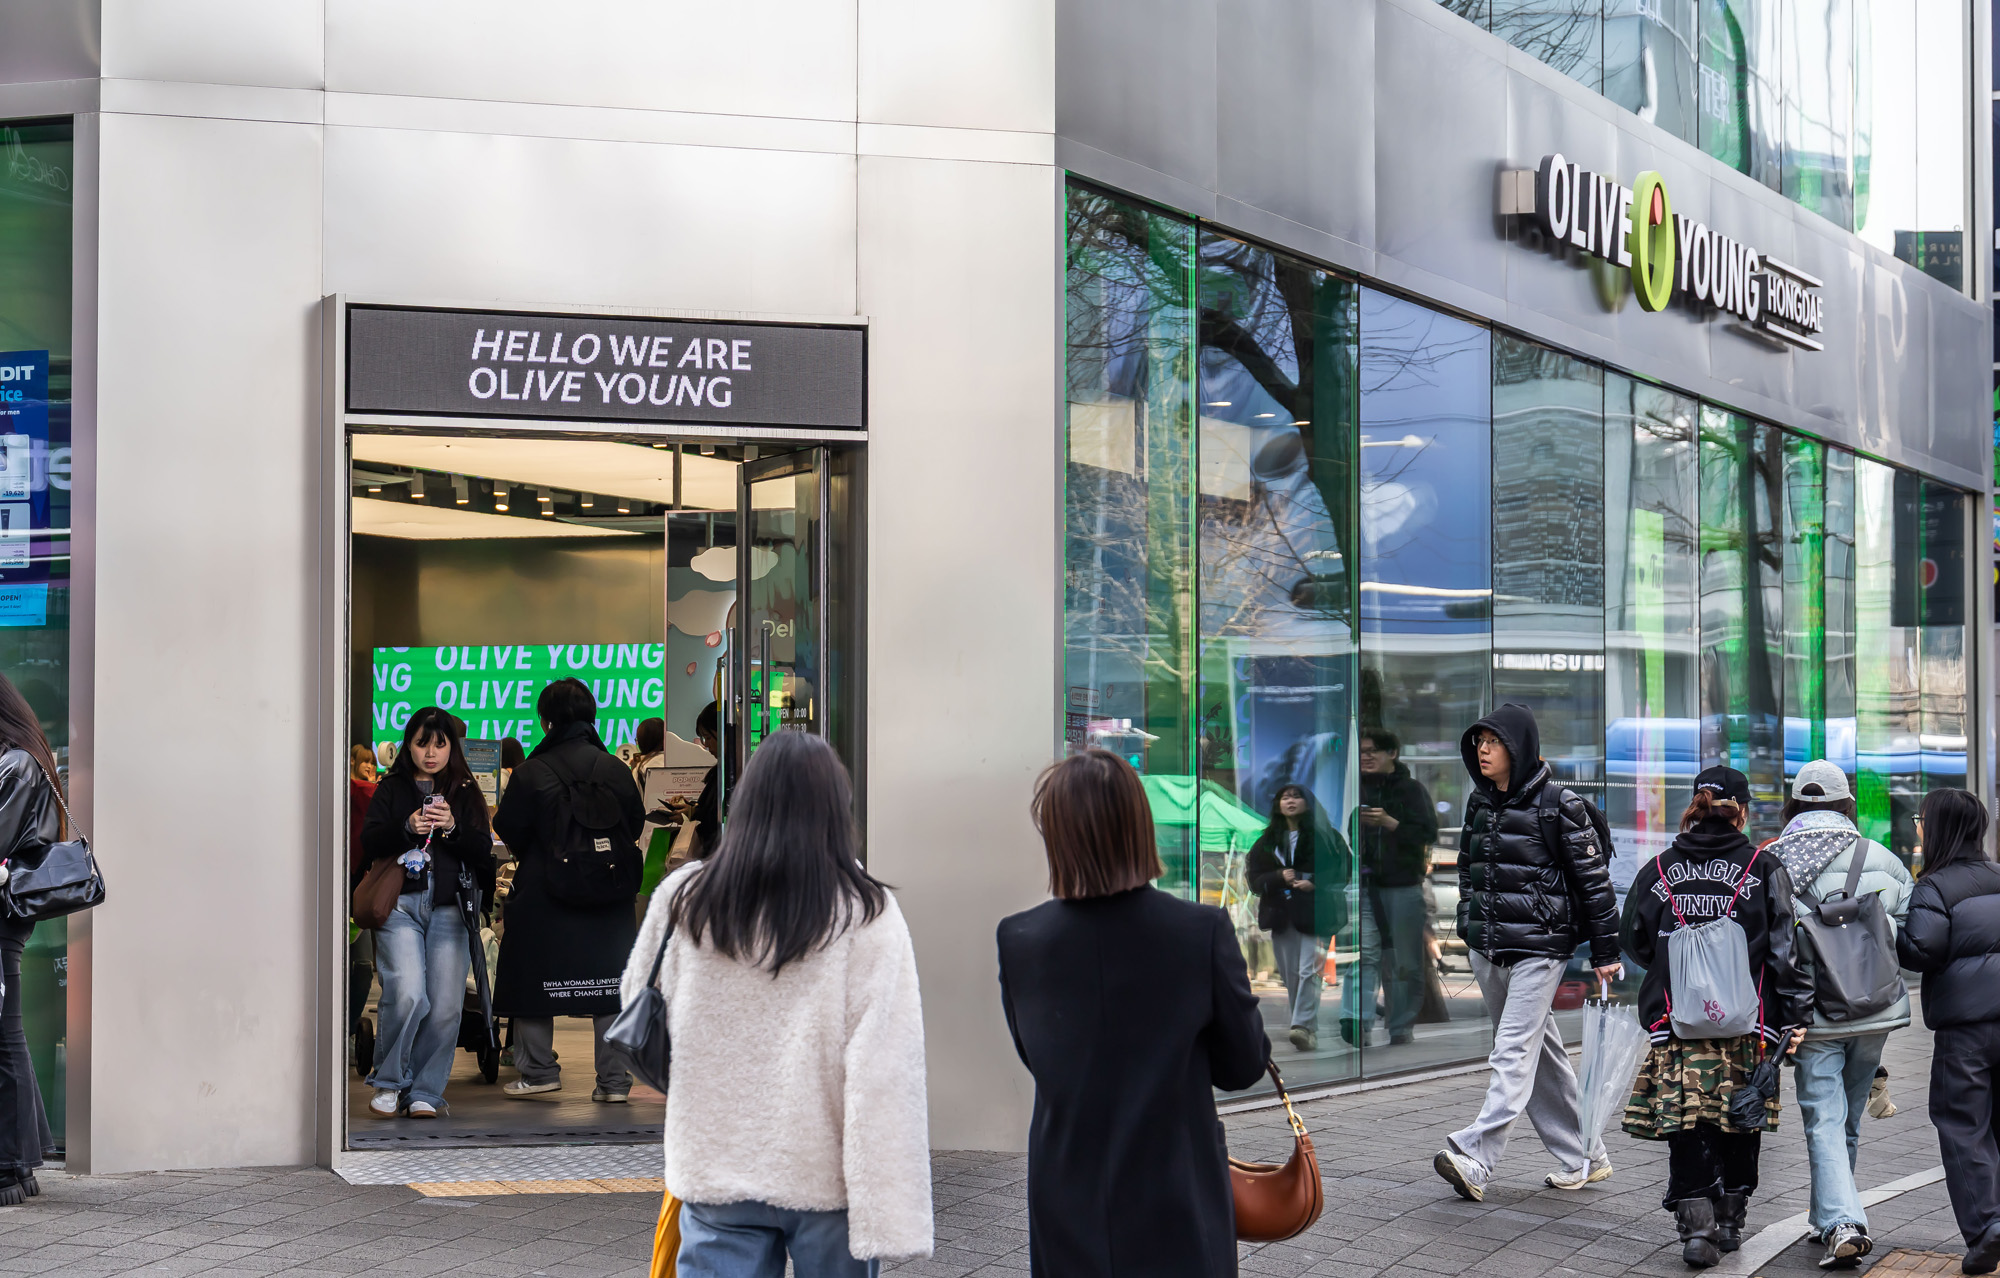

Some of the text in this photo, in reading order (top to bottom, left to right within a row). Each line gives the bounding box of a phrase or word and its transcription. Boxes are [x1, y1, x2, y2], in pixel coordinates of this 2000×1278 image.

[1548, 153, 1824, 333] OLIVE YOUNG HONGDAE
[471, 328, 752, 371] HELLO WE ARE
[468, 366, 732, 408] OLIVE YOUNG
[435, 643, 664, 671] OLIVE YOUNG
[435, 678, 663, 710] OLIVE UNG
[389, 747, 394, 760] 3
[622, 749, 630, 761] 5
[1651, 859, 1761, 902] HONGIK
[1672, 894, 1737, 918] UNIV.
[563, 979, 594, 987] WOMANS
